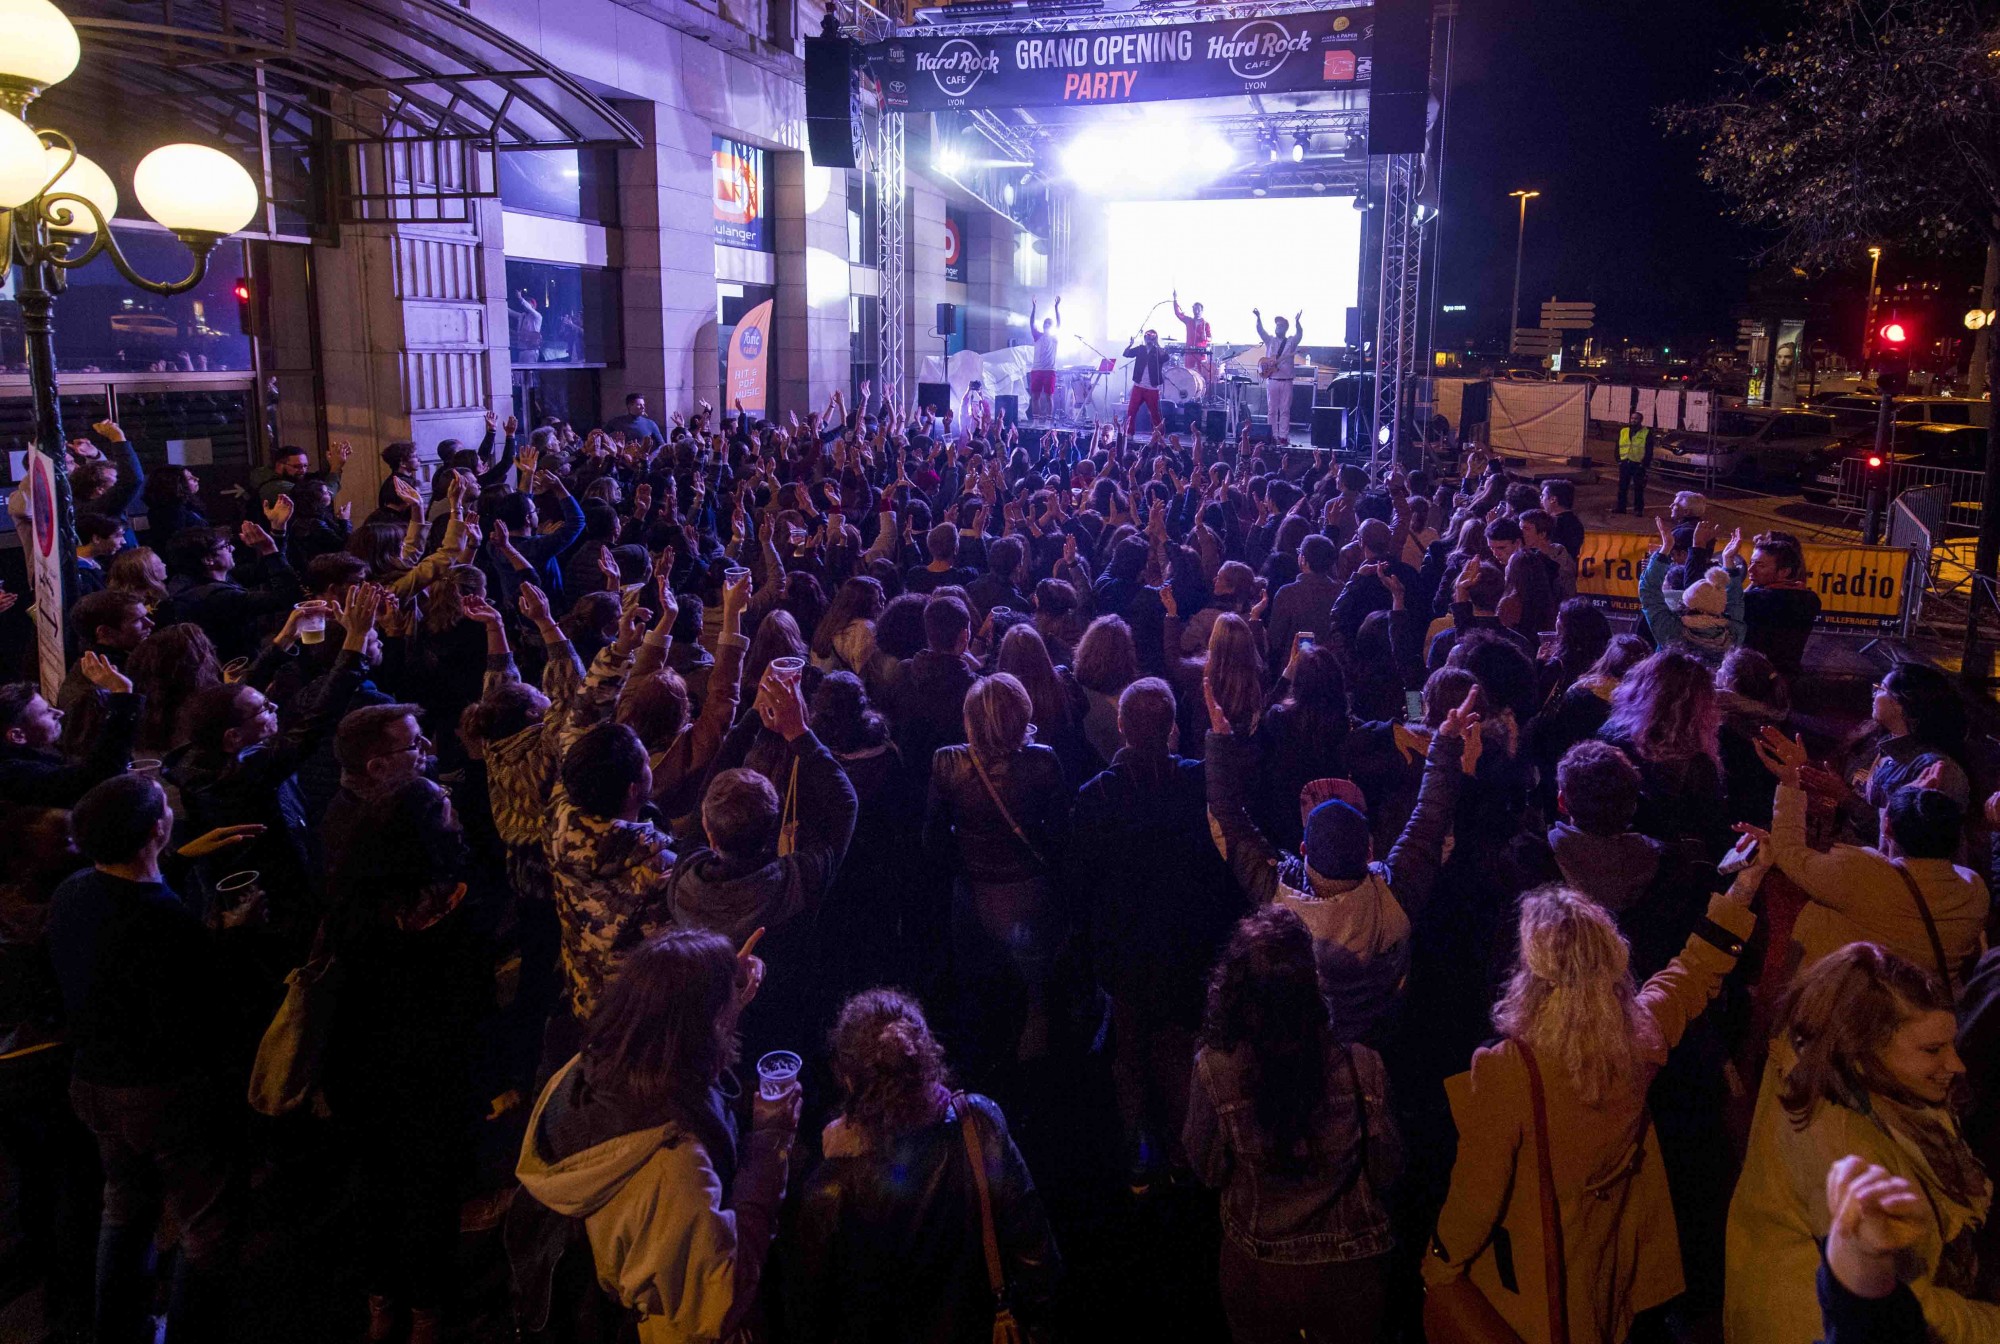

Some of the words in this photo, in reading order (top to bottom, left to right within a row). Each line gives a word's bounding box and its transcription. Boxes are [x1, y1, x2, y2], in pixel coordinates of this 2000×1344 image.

[1015, 36, 1088, 70] GRAND
[1093, 30, 1193, 66] OPENING
[1207, 33, 1260, 60] Hard
[1261, 30, 1312, 58] Rock
[915, 51, 958, 71] Hard
[958, 49, 1000, 74] Rock
[1244, 60, 1271, 70] CAFE
[946, 75, 967, 85] CAFE
[1063, 70, 1138, 100] PARTY
[1244, 81, 1267, 90] LYON
[947, 98, 965, 106] LYON
[713, 224, 757, 242] ulanger
[743, 331, 760, 346] Tonic
[734, 368, 750, 380] HIT
[738, 378, 755, 389] POP
[734, 387, 761, 399] MUSIC
[1821, 567, 1895, 600] radio
[1825, 614, 1880, 627] VILLEFRANCHE
